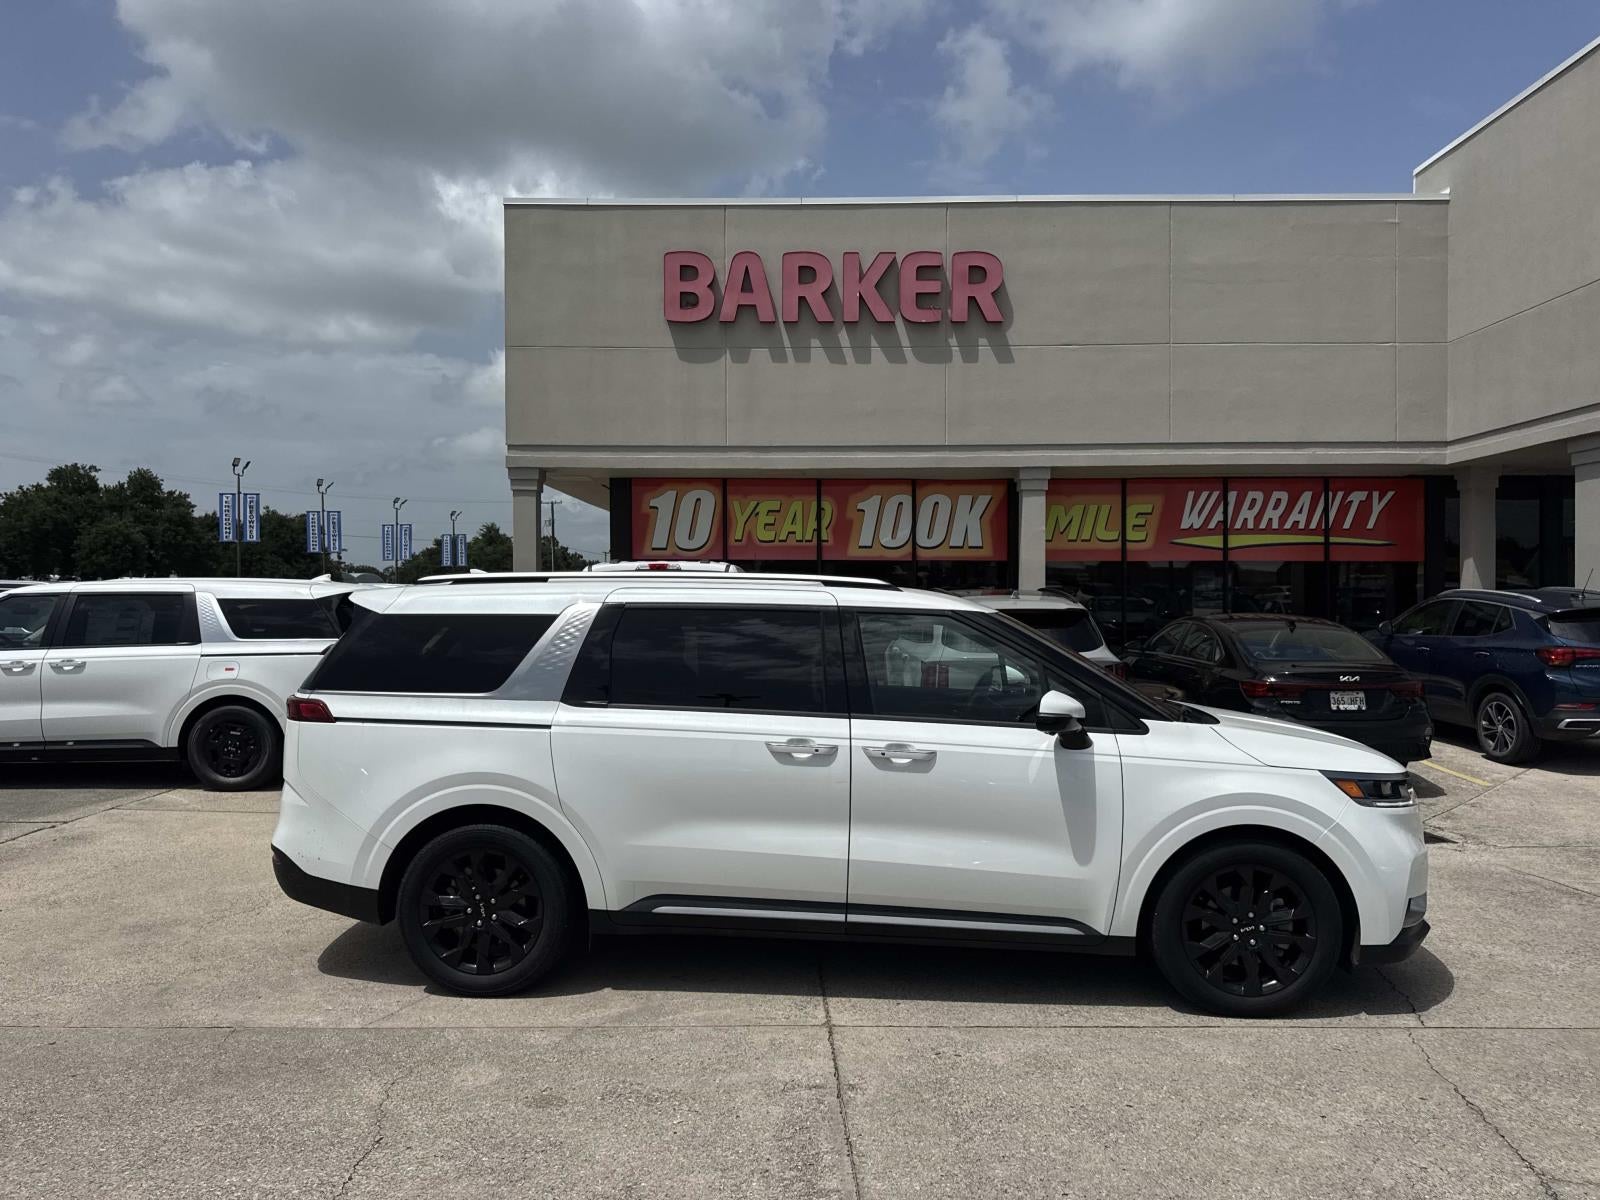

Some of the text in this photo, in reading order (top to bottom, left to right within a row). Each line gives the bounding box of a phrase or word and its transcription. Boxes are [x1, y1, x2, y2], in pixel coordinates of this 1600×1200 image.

[663, 250, 1005, 323] BARKER
[648, 489, 1396, 552] 10 YEAR 100K MILE WARRANTY
[1331, 696, 1346, 706] 365
